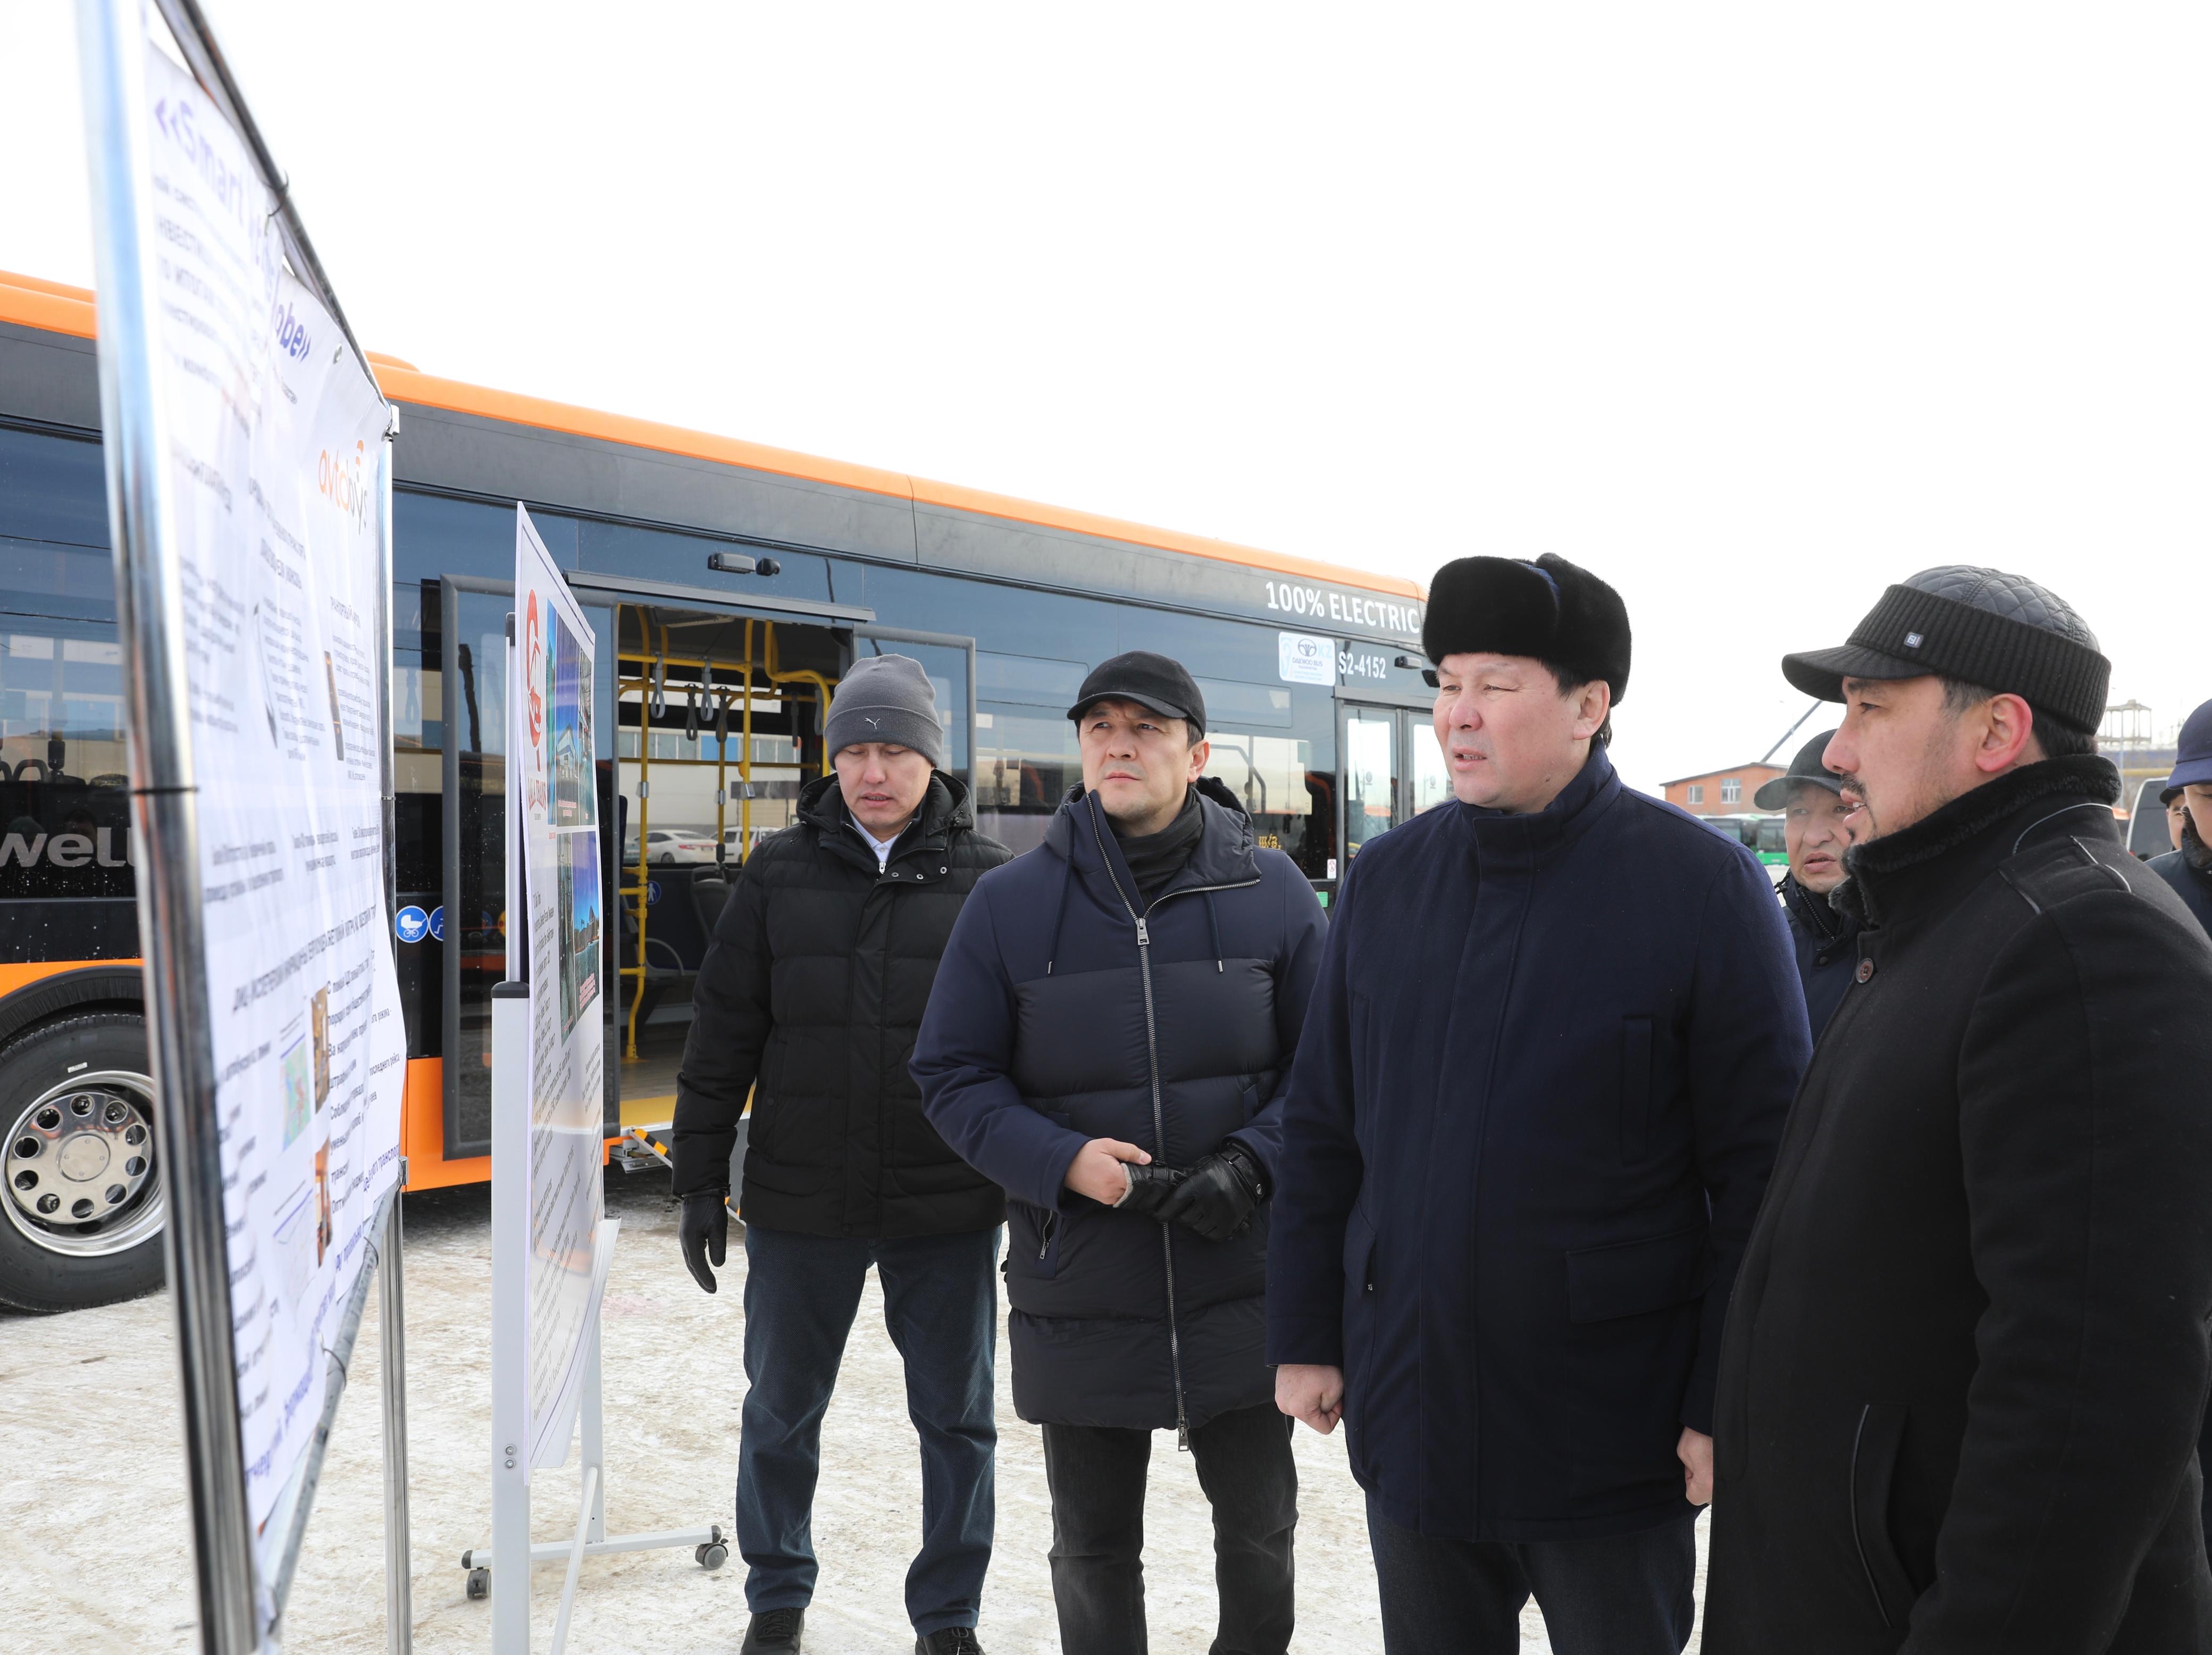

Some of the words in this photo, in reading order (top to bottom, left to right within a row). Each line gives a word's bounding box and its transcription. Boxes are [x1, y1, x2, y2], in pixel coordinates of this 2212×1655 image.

[1266, 581, 1325, 618] 100%
[1329, 593, 1419, 633] ELECTRIC
[1292, 657, 1313, 665] DAEWOO
[1338, 651, 1386, 679] S2-4152
